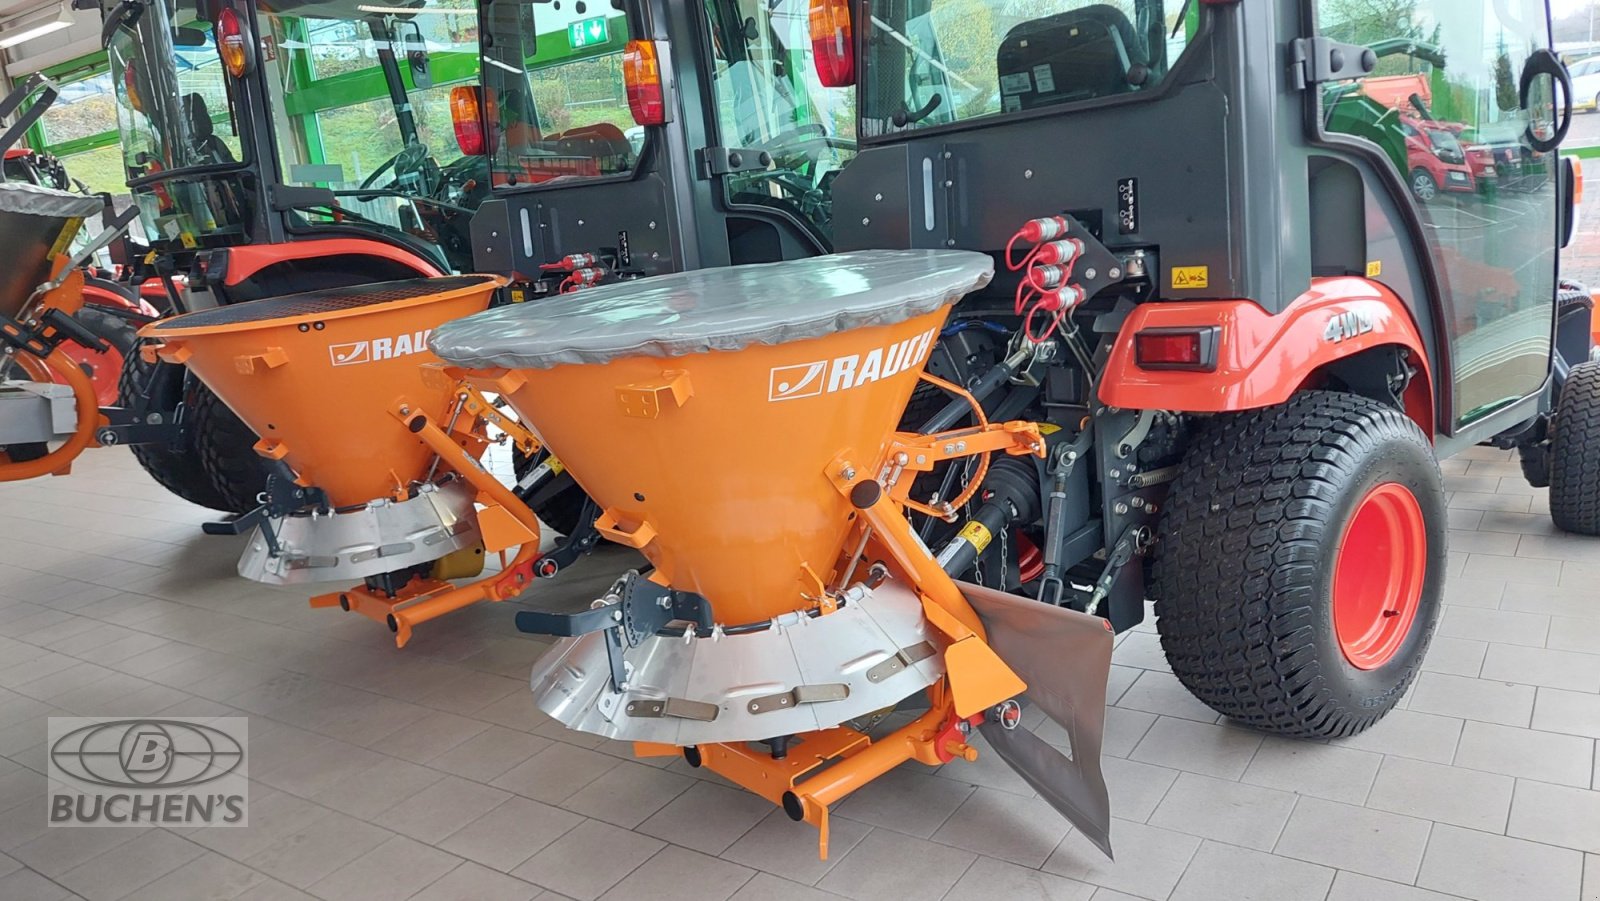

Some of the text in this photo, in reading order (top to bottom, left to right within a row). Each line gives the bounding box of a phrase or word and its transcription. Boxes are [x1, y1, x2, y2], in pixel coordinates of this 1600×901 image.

[1323, 309, 1373, 344] 4WD
[372, 329, 432, 361] RAU
[827, 327, 936, 393] RAUCH
